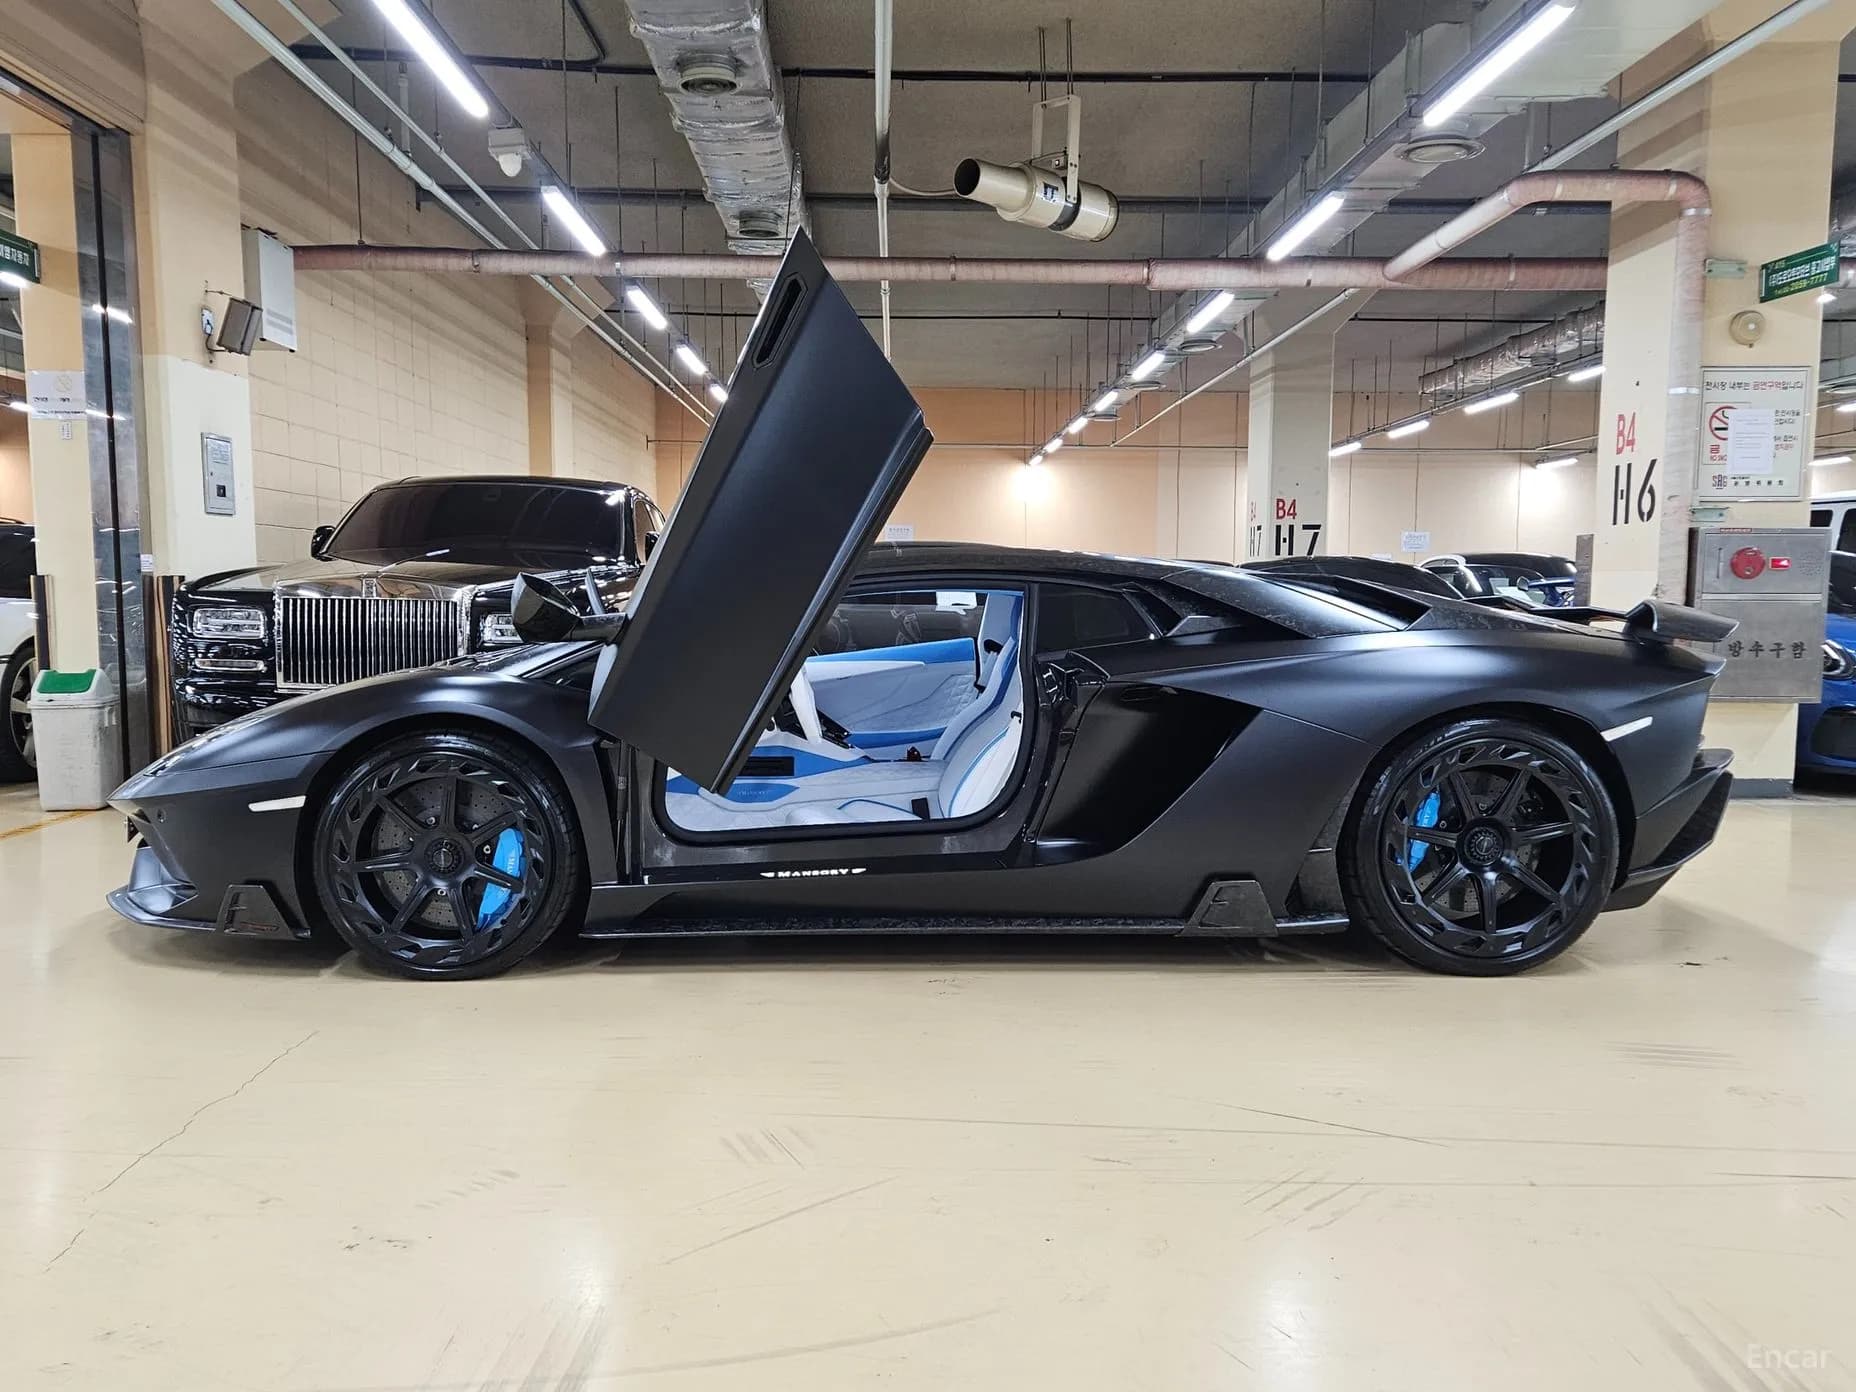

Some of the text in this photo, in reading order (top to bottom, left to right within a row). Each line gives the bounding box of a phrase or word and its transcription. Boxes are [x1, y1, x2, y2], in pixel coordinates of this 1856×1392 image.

[1616, 411, 1636, 455] B4
[1275, 498, 1297, 520] B4
[1612, 458, 1658, 526] H6
[1275, 524, 1322, 556] H7
